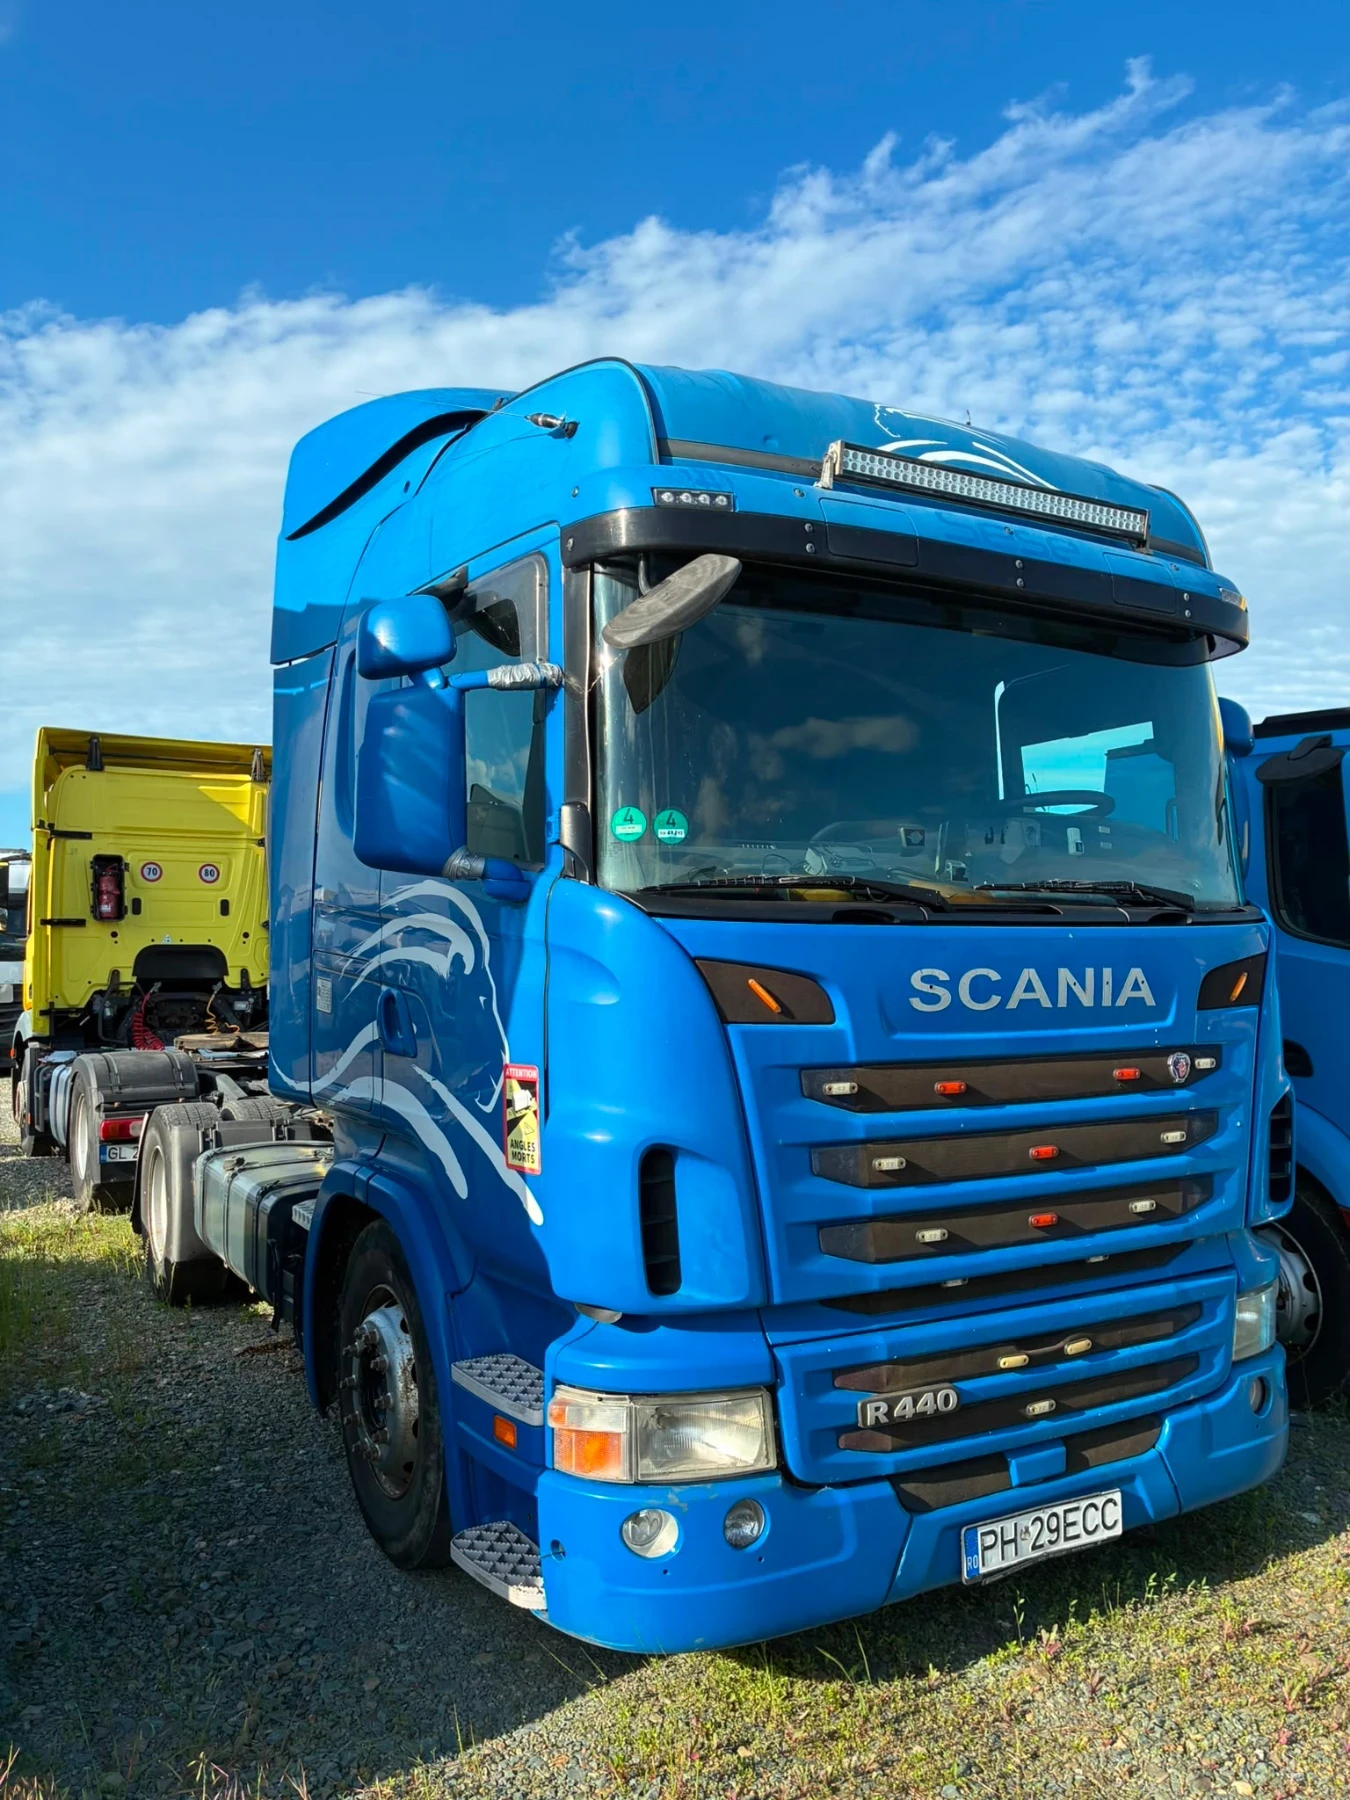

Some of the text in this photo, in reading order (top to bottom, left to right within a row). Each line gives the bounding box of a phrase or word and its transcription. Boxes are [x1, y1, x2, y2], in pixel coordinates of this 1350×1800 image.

[623, 808, 634, 824] 4
[666, 812, 676, 827] 4
[146, 867, 158, 876] 70
[204, 868, 215, 877] 80
[908, 967, 1156, 1012] SCANIA
[505, 1068, 537, 1079] ATTENTION
[510, 1139, 535, 1151] ANGLES
[108, 1146, 127, 1160] GL
[512, 1151, 535, 1164] MORTS
[966, 1554, 979, 1571] RO
